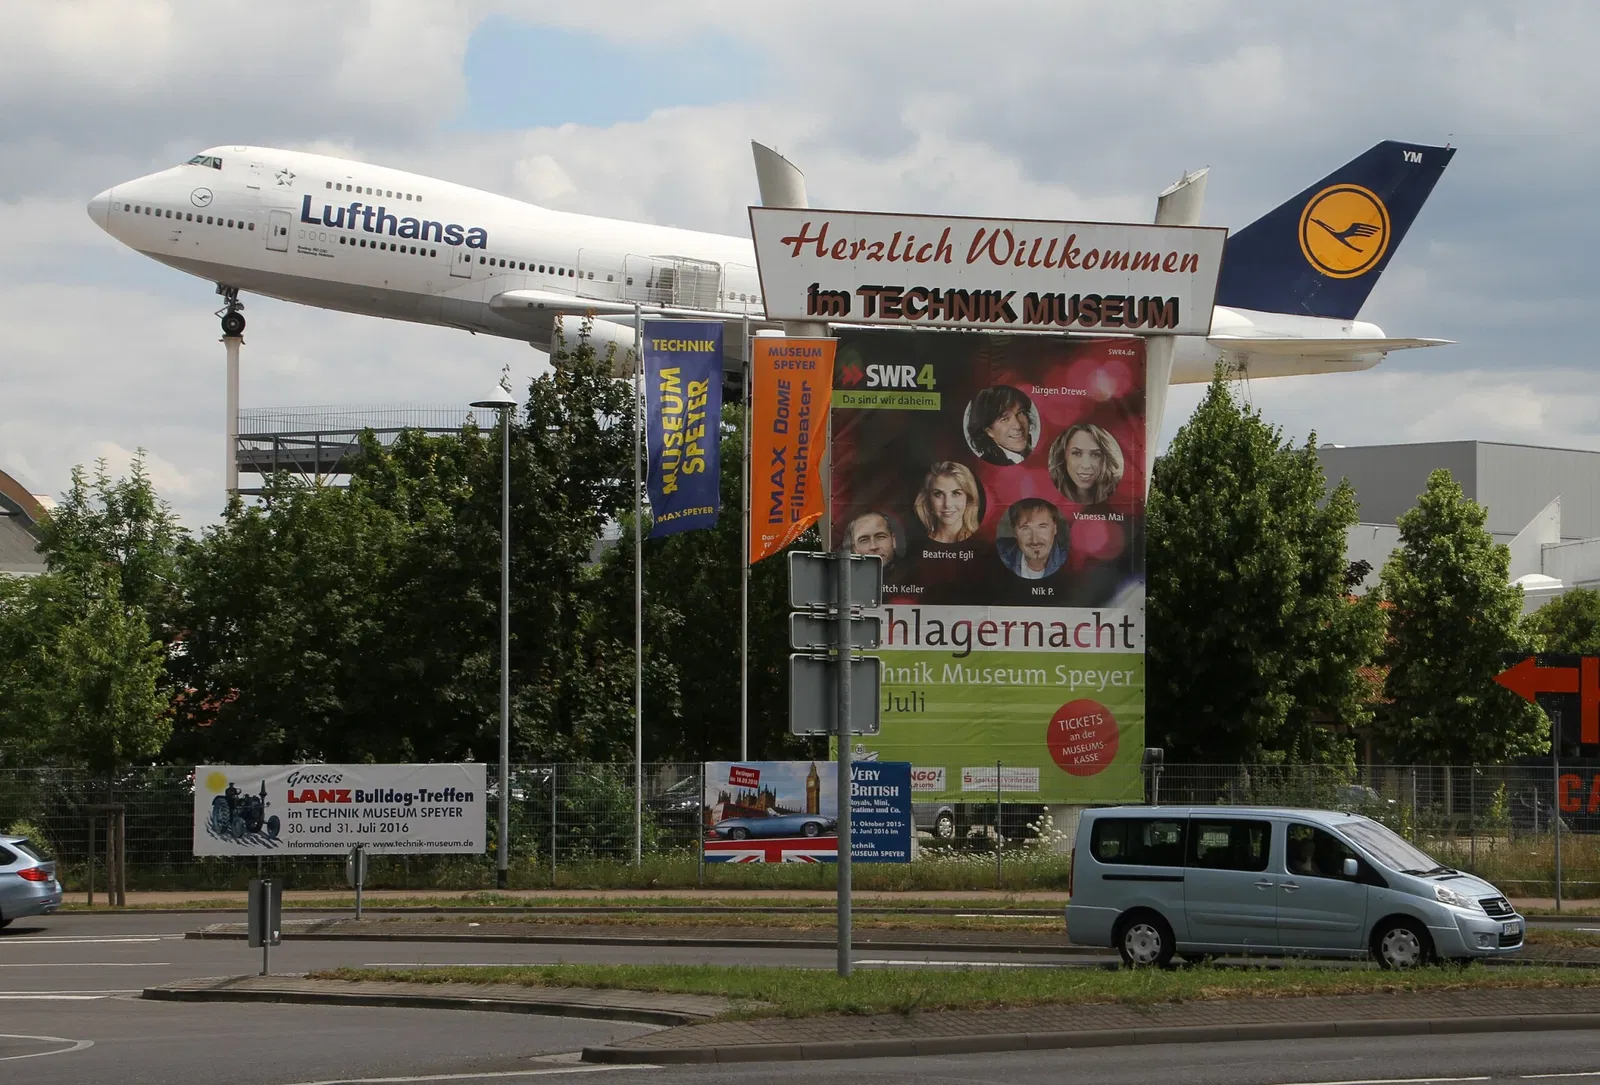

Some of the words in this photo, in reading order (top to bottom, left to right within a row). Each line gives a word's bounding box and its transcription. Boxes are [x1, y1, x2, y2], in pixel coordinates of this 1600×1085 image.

[1403, 150, 1423, 164] YM
[301, 195, 487, 249] Lufthansa
[781, 222, 953, 265] Herzlich
[966, 227, 1199, 273] Willkommen
[807, 282, 850, 317] im
[856, 285, 1018, 324] TECHNIK
[1022, 291, 1179, 330] MUSEUM
[652, 339, 715, 352] TECHNIK
[768, 347, 822, 357] MUSEUM
[1108, 348, 1135, 357] SWR4.de
[774, 359, 816, 370] SPEYER
[866, 363, 936, 390] SWR4
[1031, 386, 1059, 397] Jürgen
[1061, 387, 1087, 396] Drews
[842, 394, 857, 405] Da
[857, 394, 878, 405] sind
[880, 394, 896, 405] wir
[897, 395, 937, 407] daheim.
[659, 367, 683, 495] MUSEUM
[682, 377, 709, 475] SPEYER
[791, 380, 812, 524] Filmtheater
[768, 445, 787, 524] IMAX
[656, 511, 681, 524] MAX
[682, 506, 714, 517] SPEYER
[1073, 512, 1106, 521] Vanessa
[1108, 512, 1124, 521] Mai
[922, 550, 956, 559] Beatrice
[958, 550, 974, 561] Egli
[881, 584, 898, 593] itch
[900, 585, 924, 593] Keller
[1031, 586, 1047, 595] Nik
[1048, 587, 1055, 595] P.
[881, 608, 1135, 658] hlagernacht
[942, 664, 1047, 685] Museum
[1055, 665, 1135, 692] Speyer
[884, 691, 925, 712] Juli
[1058, 714, 1103, 732] TICKETS
[1069, 733, 1081, 741] an
[1082, 730, 1096, 740] der
[1062, 742, 1107, 756] MUSEUMS-
[1074, 753, 1099, 764] KASSE
[287, 771, 343, 786] Grosses
[850, 766, 880, 781] VERY
[850, 782, 899, 797] BRITISH
[287, 789, 352, 804] LANZ
[355, 787, 474, 807] Bulldog-Treffen
[288, 808, 302, 819] im
[305, 808, 360, 819] TECHNIK
[363, 807, 417, 819] MUSEUM
[420, 807, 463, 818] SPEYER
[288, 822, 306, 834] 30.
[309, 822, 332, 834] und
[336, 822, 353, 834] 31.
[356, 822, 376, 834] Juli
[379, 822, 409, 834] 2016
[287, 840, 343, 848] Informationen
[347, 841, 371, 849] unter:
[372, 839, 473, 848] www.technik-museum.de
